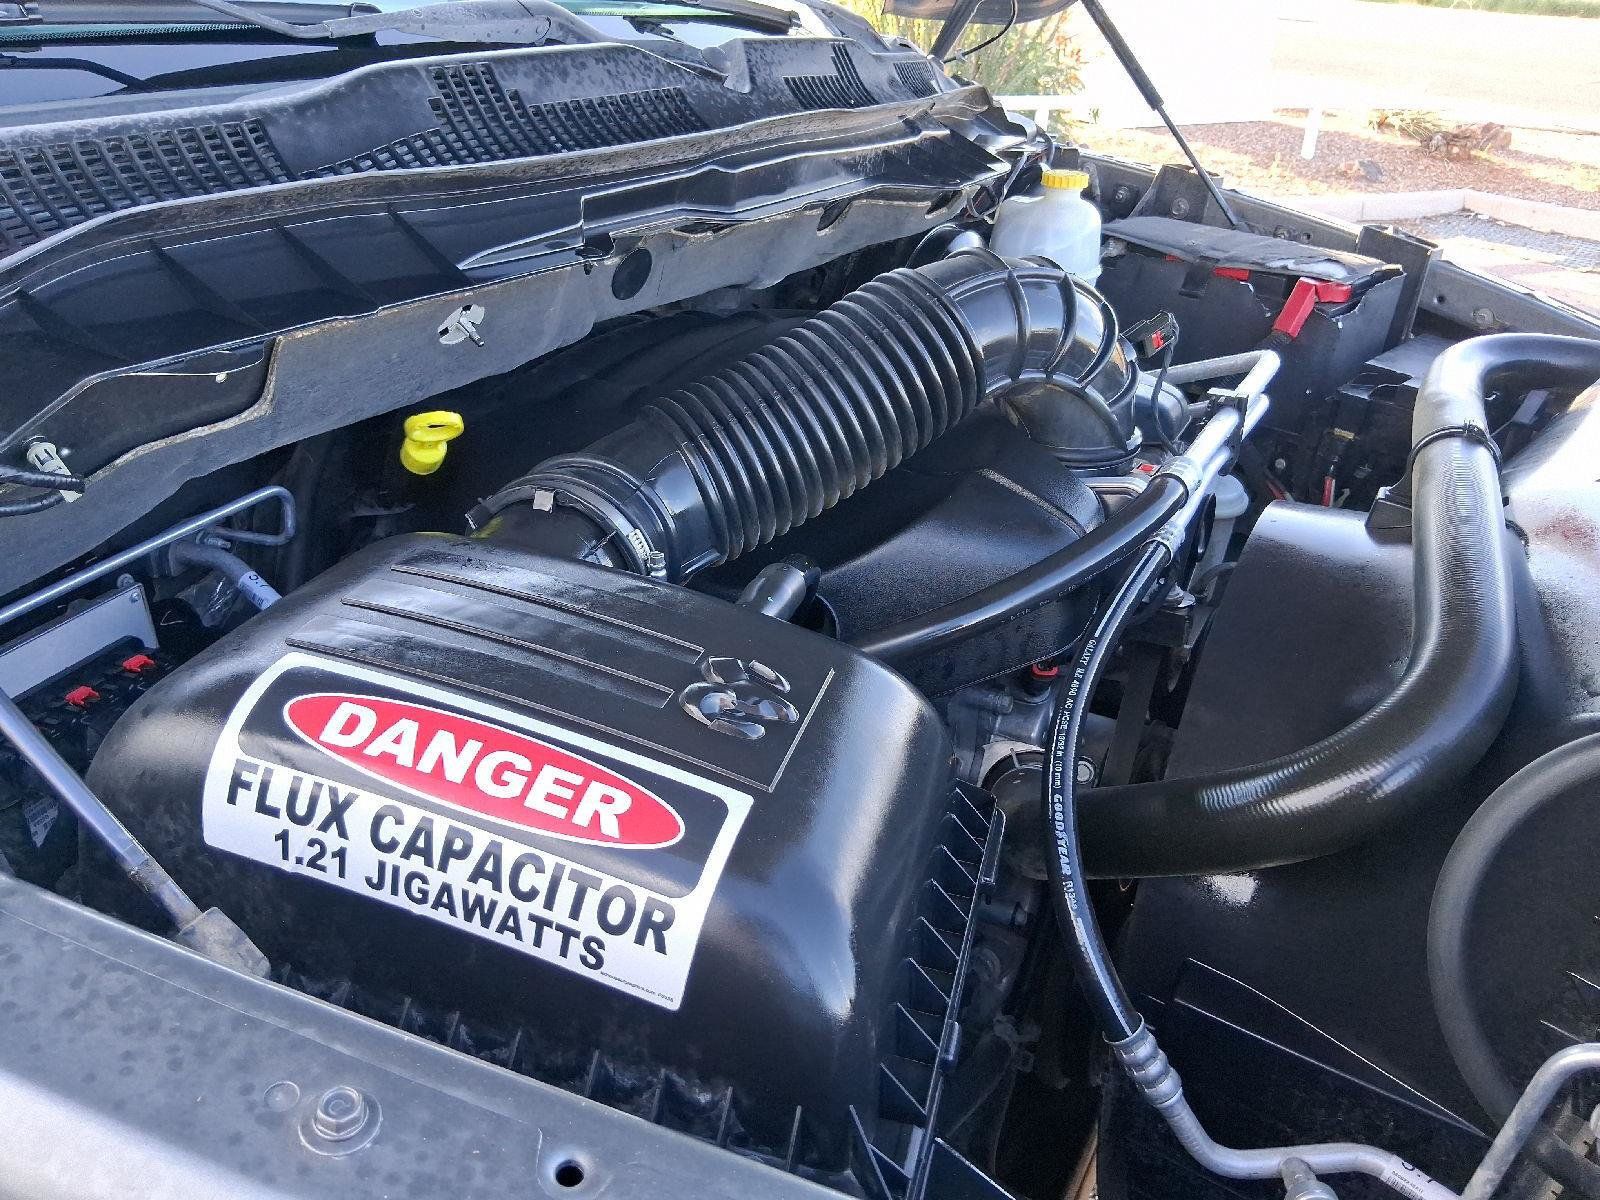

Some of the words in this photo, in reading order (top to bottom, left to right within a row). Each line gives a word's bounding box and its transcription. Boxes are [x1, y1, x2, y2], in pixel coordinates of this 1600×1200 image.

[1080, 639, 1096, 666] GALAXY
[319, 701, 633, 839] DANGER
[1053, 794, 1072, 876] GOODYEAR
[227, 758, 360, 840] FLUX
[369, 804, 676, 956] CAPACITOR
[274, 828, 348, 879] 1.21
[365, 861, 606, 972] JIGAWATTS
